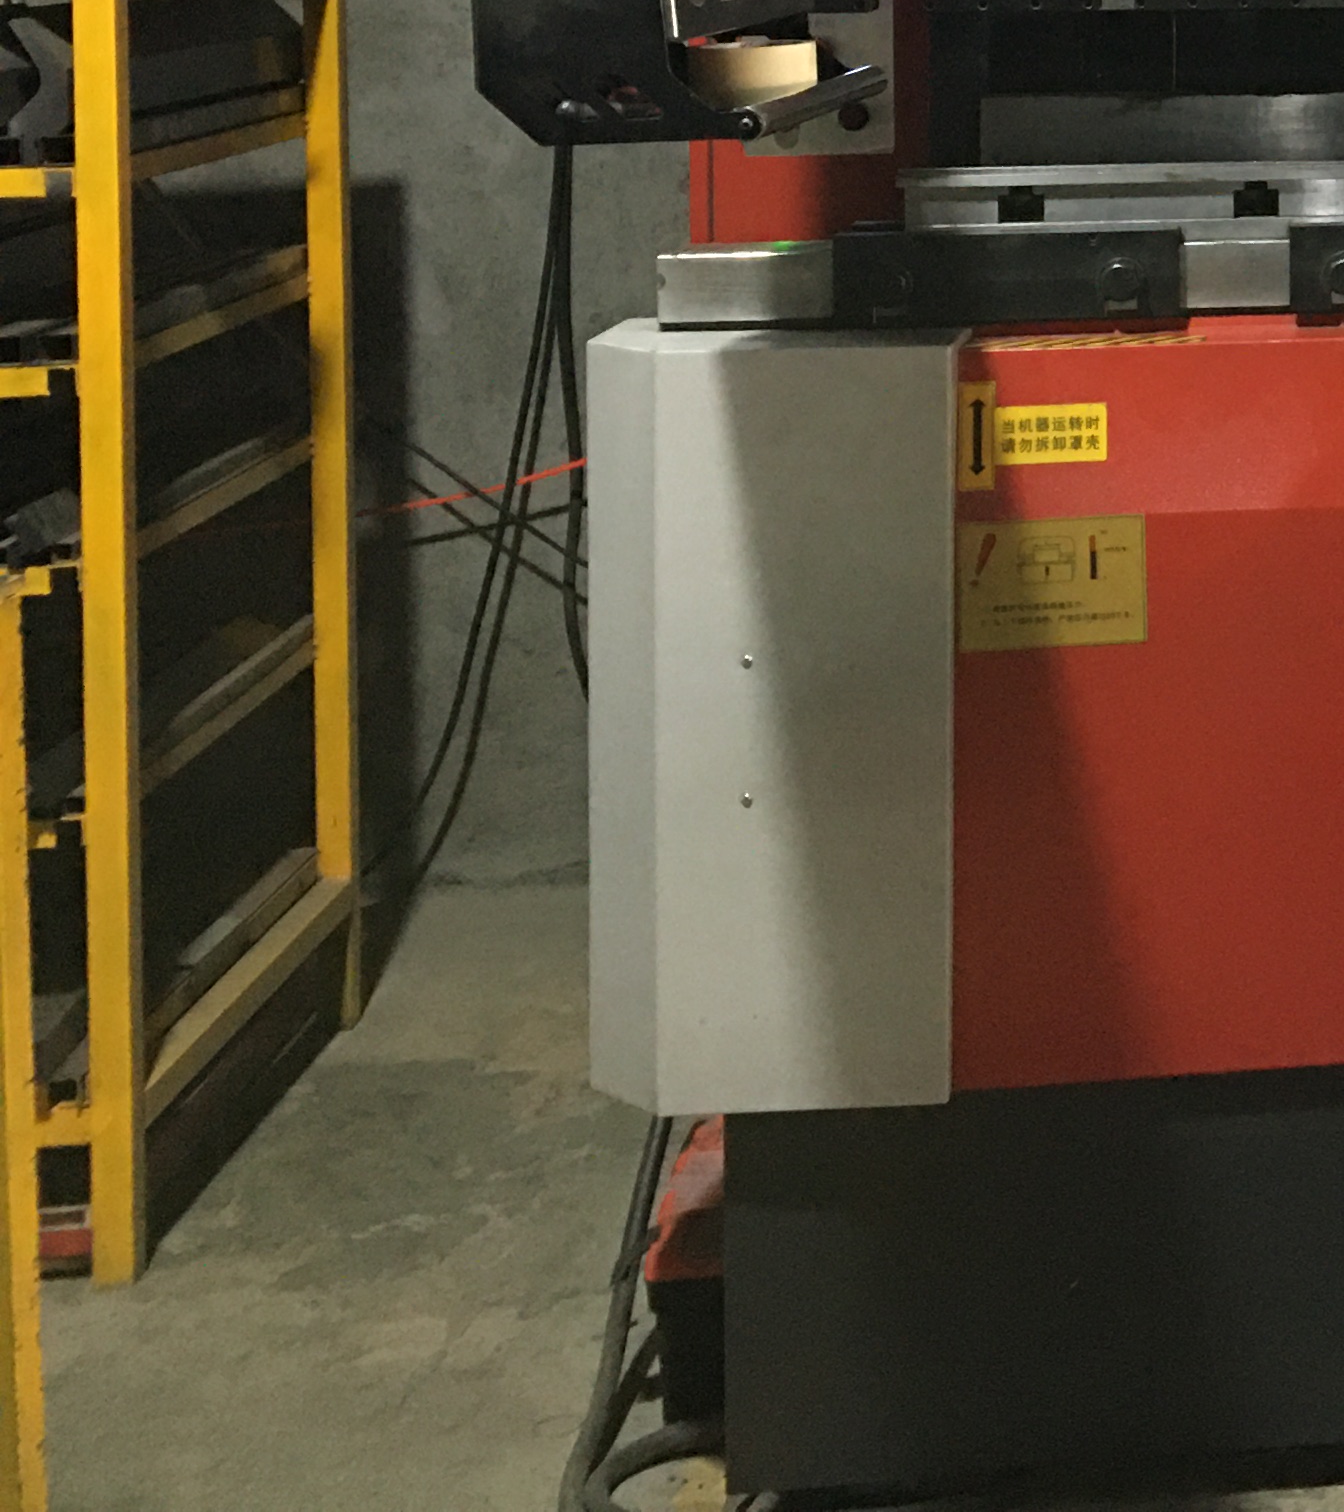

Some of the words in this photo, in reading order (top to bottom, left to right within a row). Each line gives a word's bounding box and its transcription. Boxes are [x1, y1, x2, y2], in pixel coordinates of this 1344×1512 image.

[1001, 415, 1100, 434] 当机器运转时
[1001, 434, 1100, 454] 请勿拆卸罩壳
